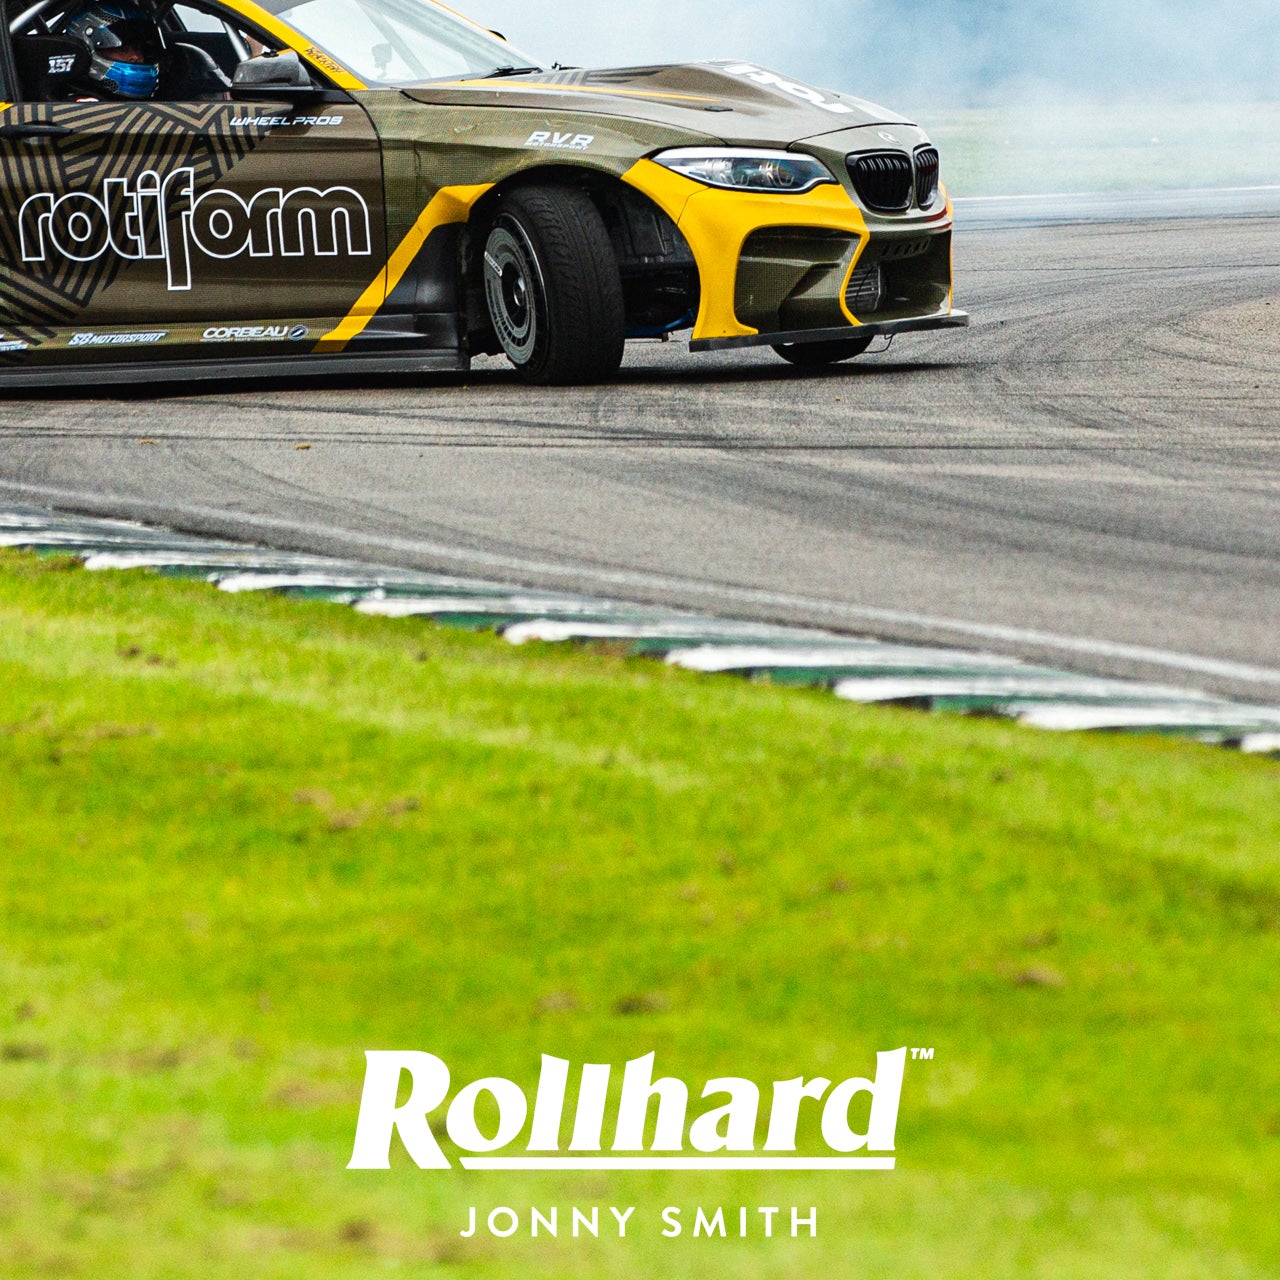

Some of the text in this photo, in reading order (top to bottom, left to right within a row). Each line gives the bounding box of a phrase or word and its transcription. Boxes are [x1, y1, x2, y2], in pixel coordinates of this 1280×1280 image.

[48, 58, 75, 73] 157
[230, 115, 343, 126] WHEEL PROS
[525, 131, 595, 147] RVR
[19, 167, 371, 290] rotiform
[202, 326, 289, 338] CORBEAU
